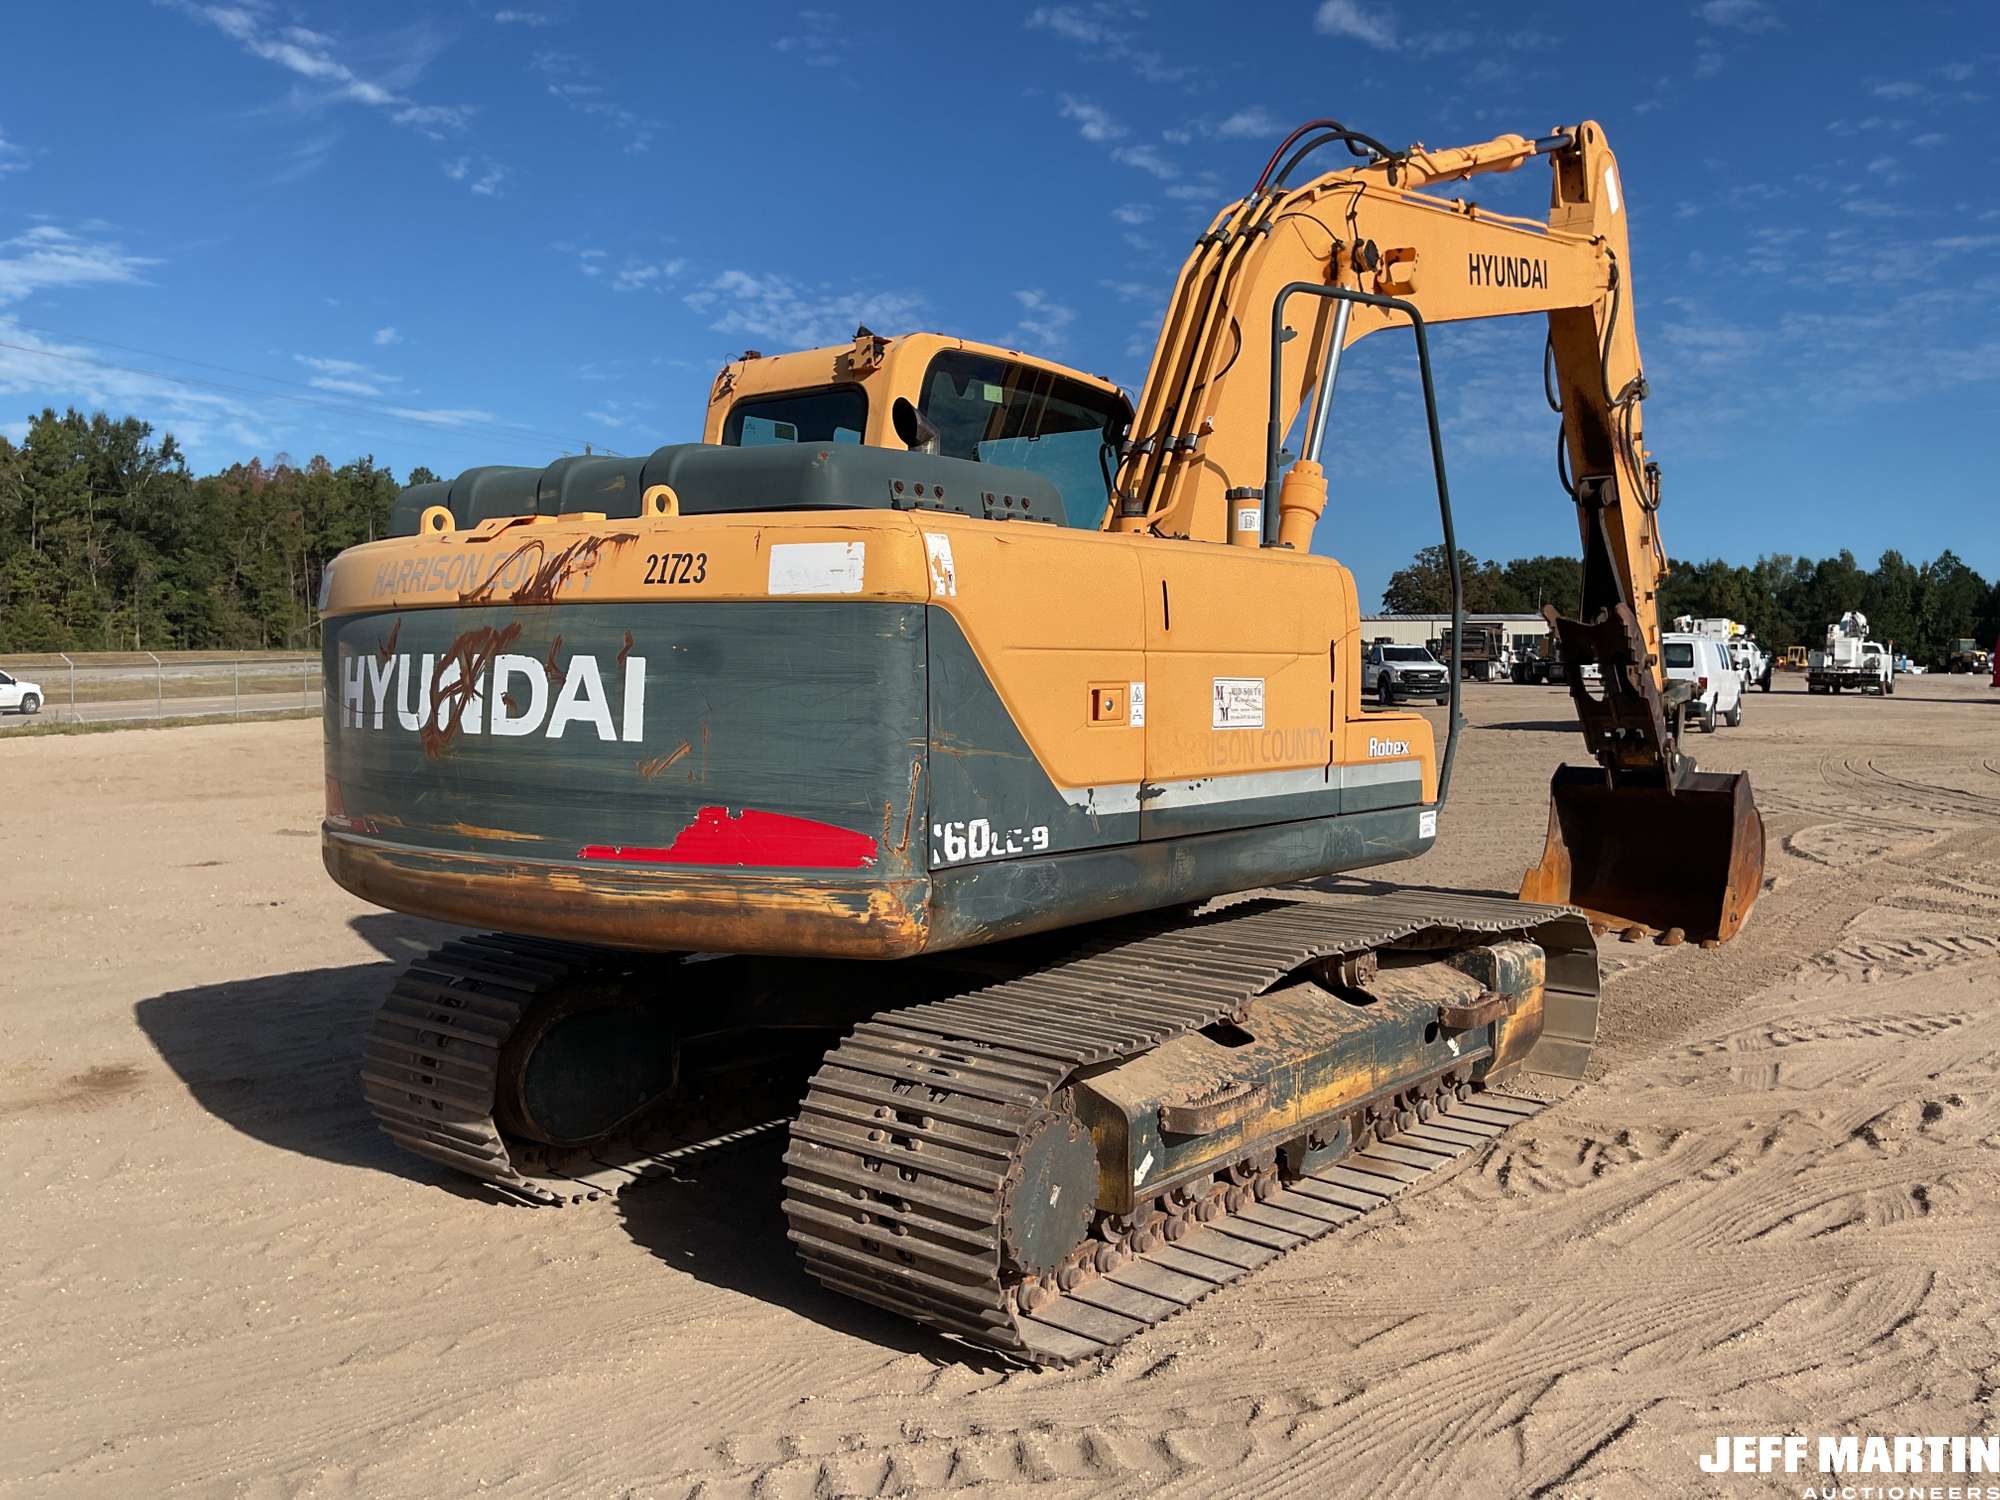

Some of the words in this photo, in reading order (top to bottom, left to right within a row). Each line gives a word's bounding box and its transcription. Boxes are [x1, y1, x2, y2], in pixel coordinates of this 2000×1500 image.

[1468, 252, 1548, 290] HYUNDAI
[371, 552, 485, 598] HARRISON
[643, 552, 708, 585] 21723
[343, 653, 647, 742] HYUNDAI
[1260, 728, 1327, 763] COUNTY
[1369, 736, 1409, 758] Robex
